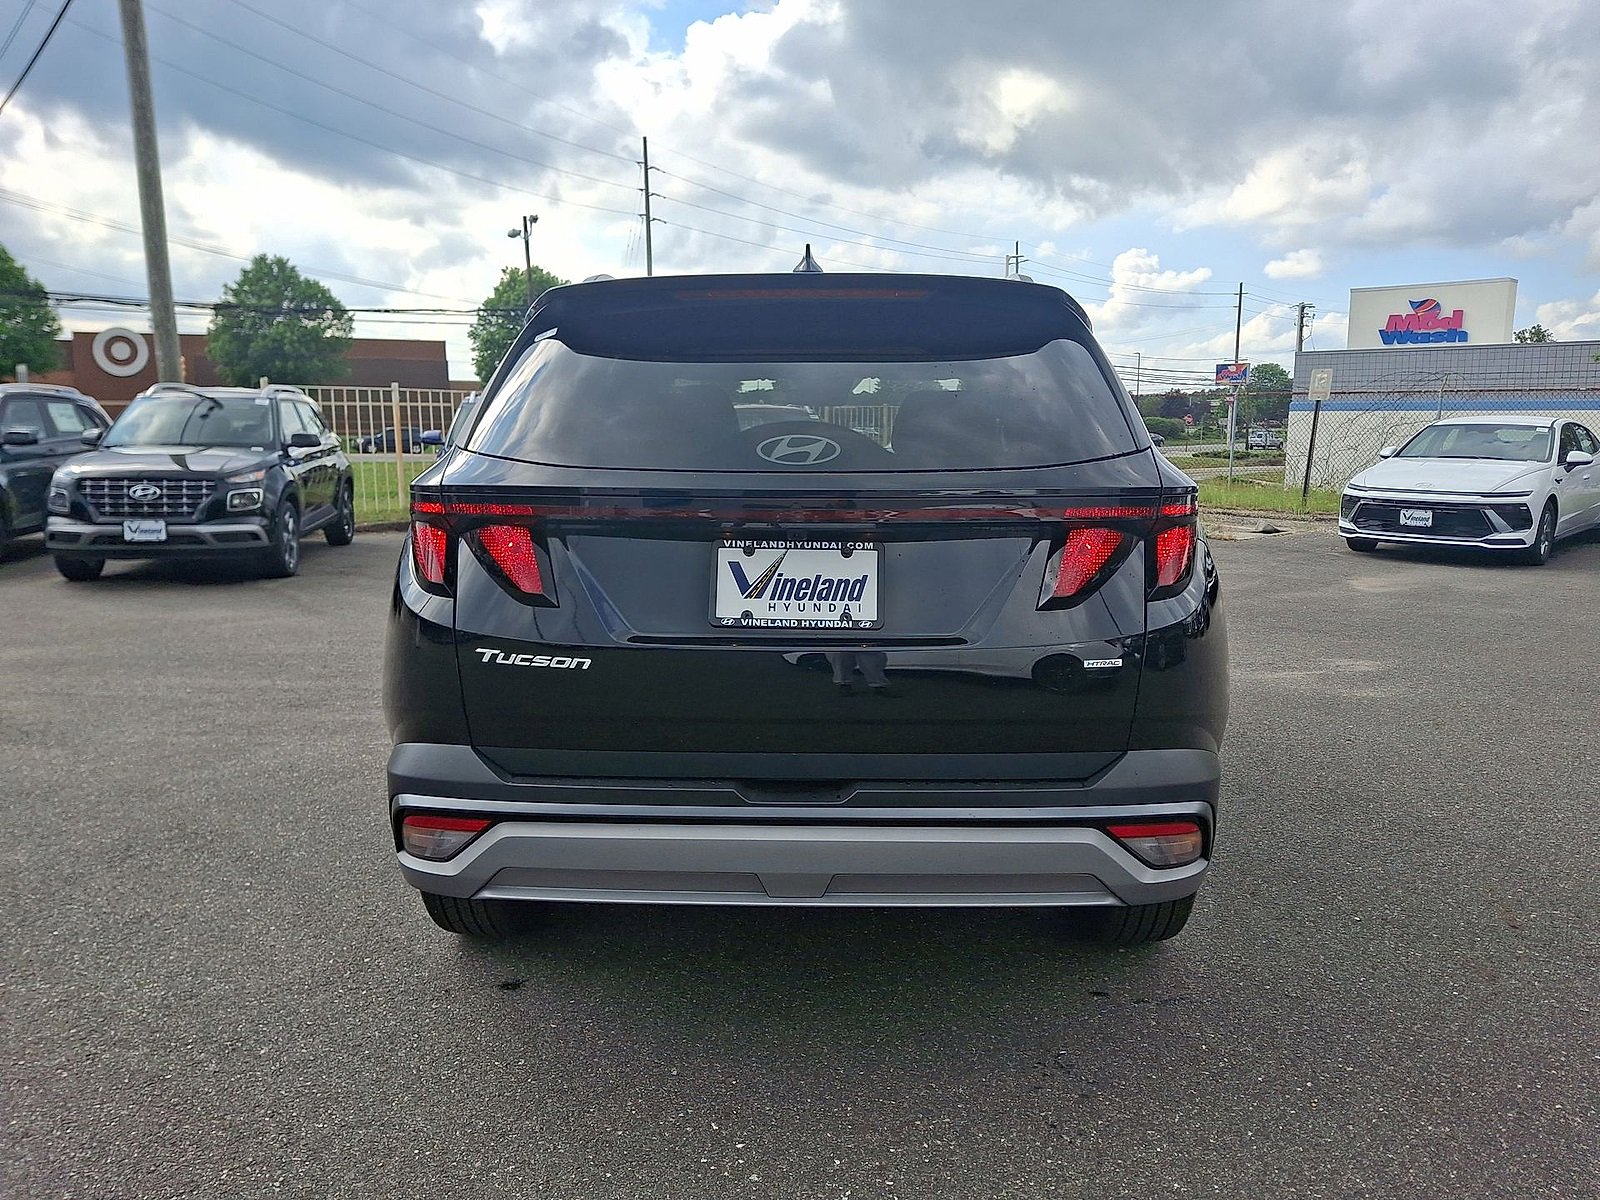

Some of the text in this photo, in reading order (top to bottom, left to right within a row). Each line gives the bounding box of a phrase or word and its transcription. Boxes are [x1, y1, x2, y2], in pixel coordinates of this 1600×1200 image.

[1385, 307, 1464, 330] Mod
[1378, 328, 1468, 345] Wash
[727, 549, 869, 602] Vineland
[768, 603, 862, 613] HYUNDAI
[740, 618, 853, 628] VINELAND HYUNDAI
